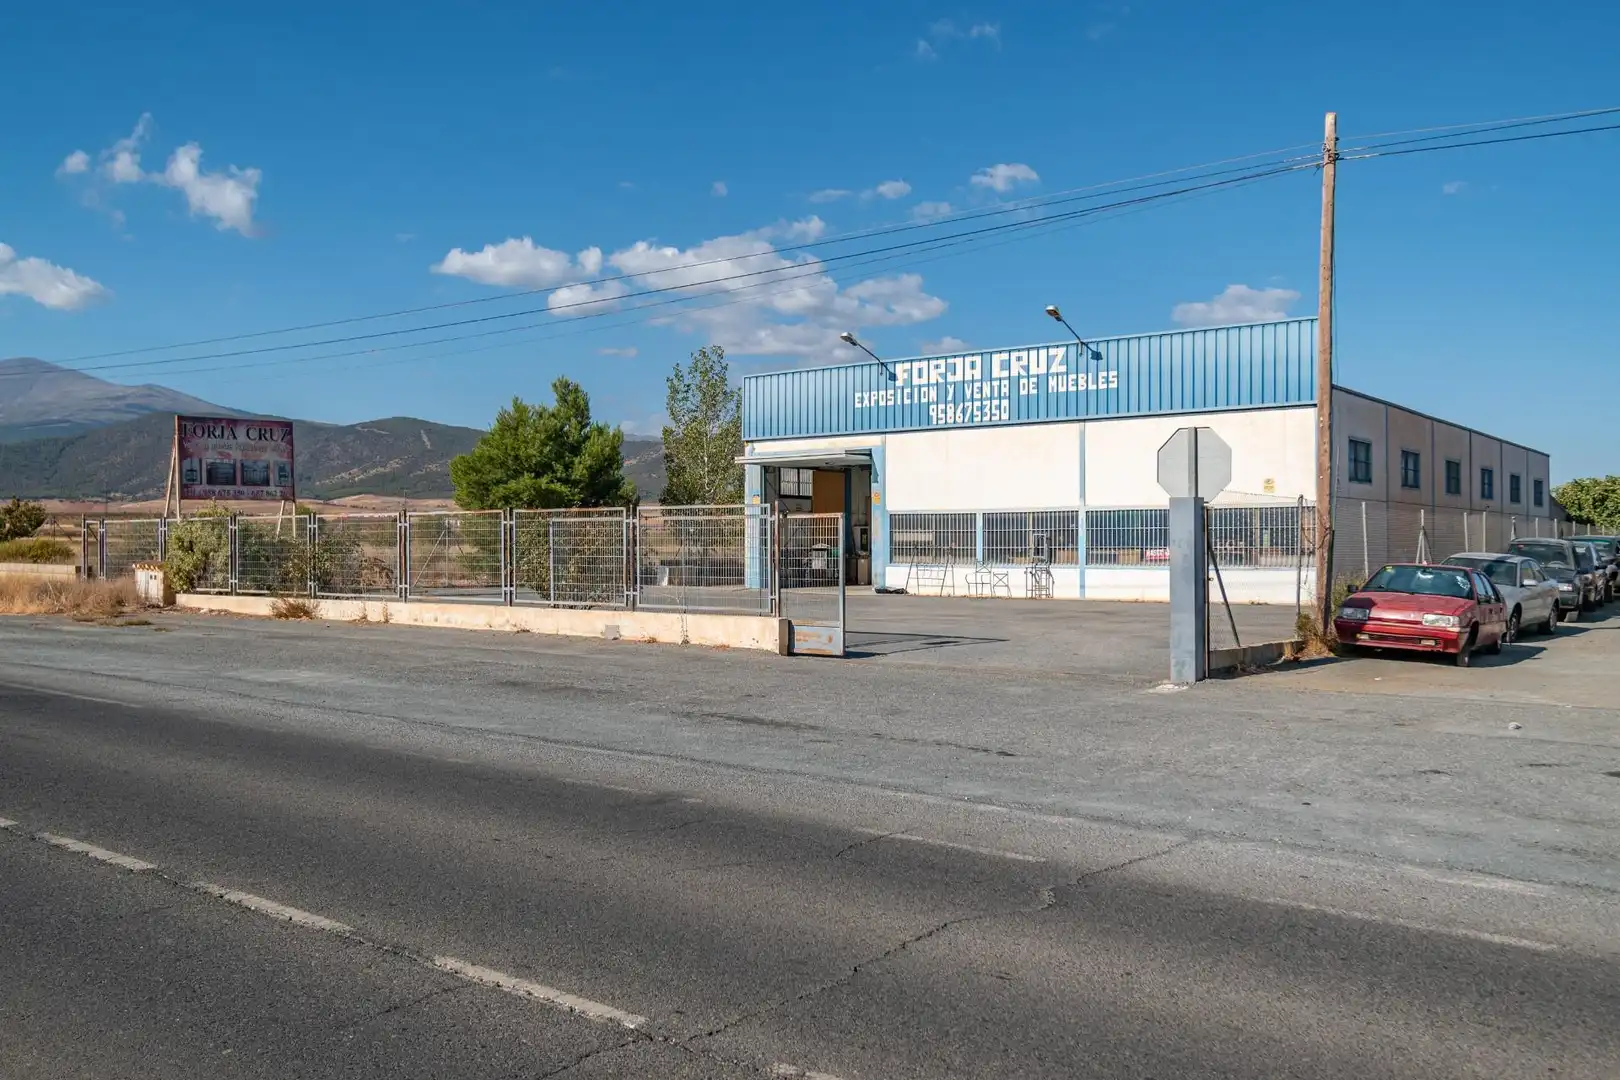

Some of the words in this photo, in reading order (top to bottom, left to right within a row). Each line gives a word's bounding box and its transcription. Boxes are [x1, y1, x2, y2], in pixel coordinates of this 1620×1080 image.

[895, 355, 981, 386] FORJA
[992, 347, 1068, 378] CRUZ
[946, 385, 955, 401] Y
[965, 379, 1009, 400] VENTA
[1019, 377, 1038, 396] DE
[1048, 370, 1118, 393] MUEBLES
[929, 399, 1009, 425] 958675350
[182, 422, 238, 441] FORJA
[246, 425, 290, 442] CRUZ
